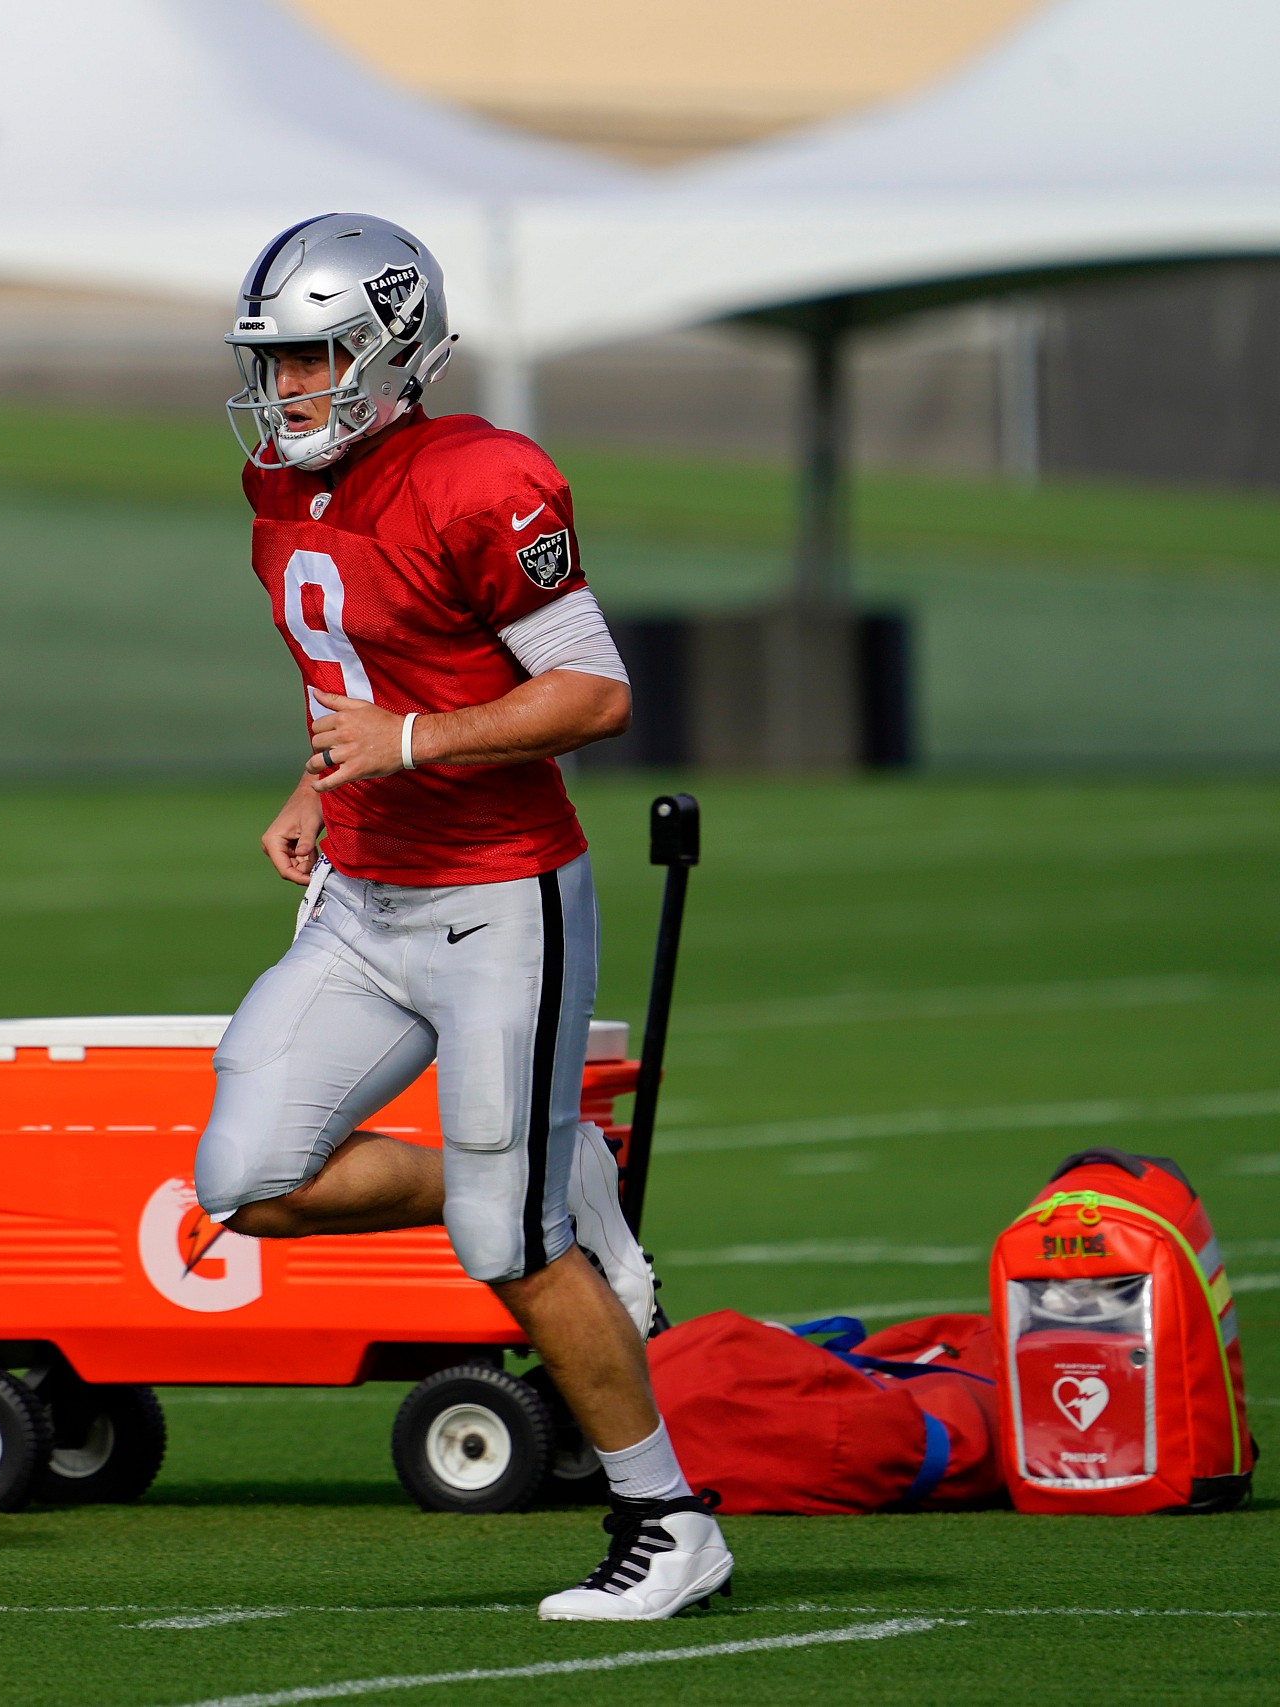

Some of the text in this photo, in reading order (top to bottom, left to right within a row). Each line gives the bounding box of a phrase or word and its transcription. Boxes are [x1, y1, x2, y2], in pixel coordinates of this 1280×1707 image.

[370, 269, 415, 290] RAIDERS
[523, 534, 562, 559] RAIDERS
[284, 549, 374, 720] 9
[138, 1177, 263, 1313] G
